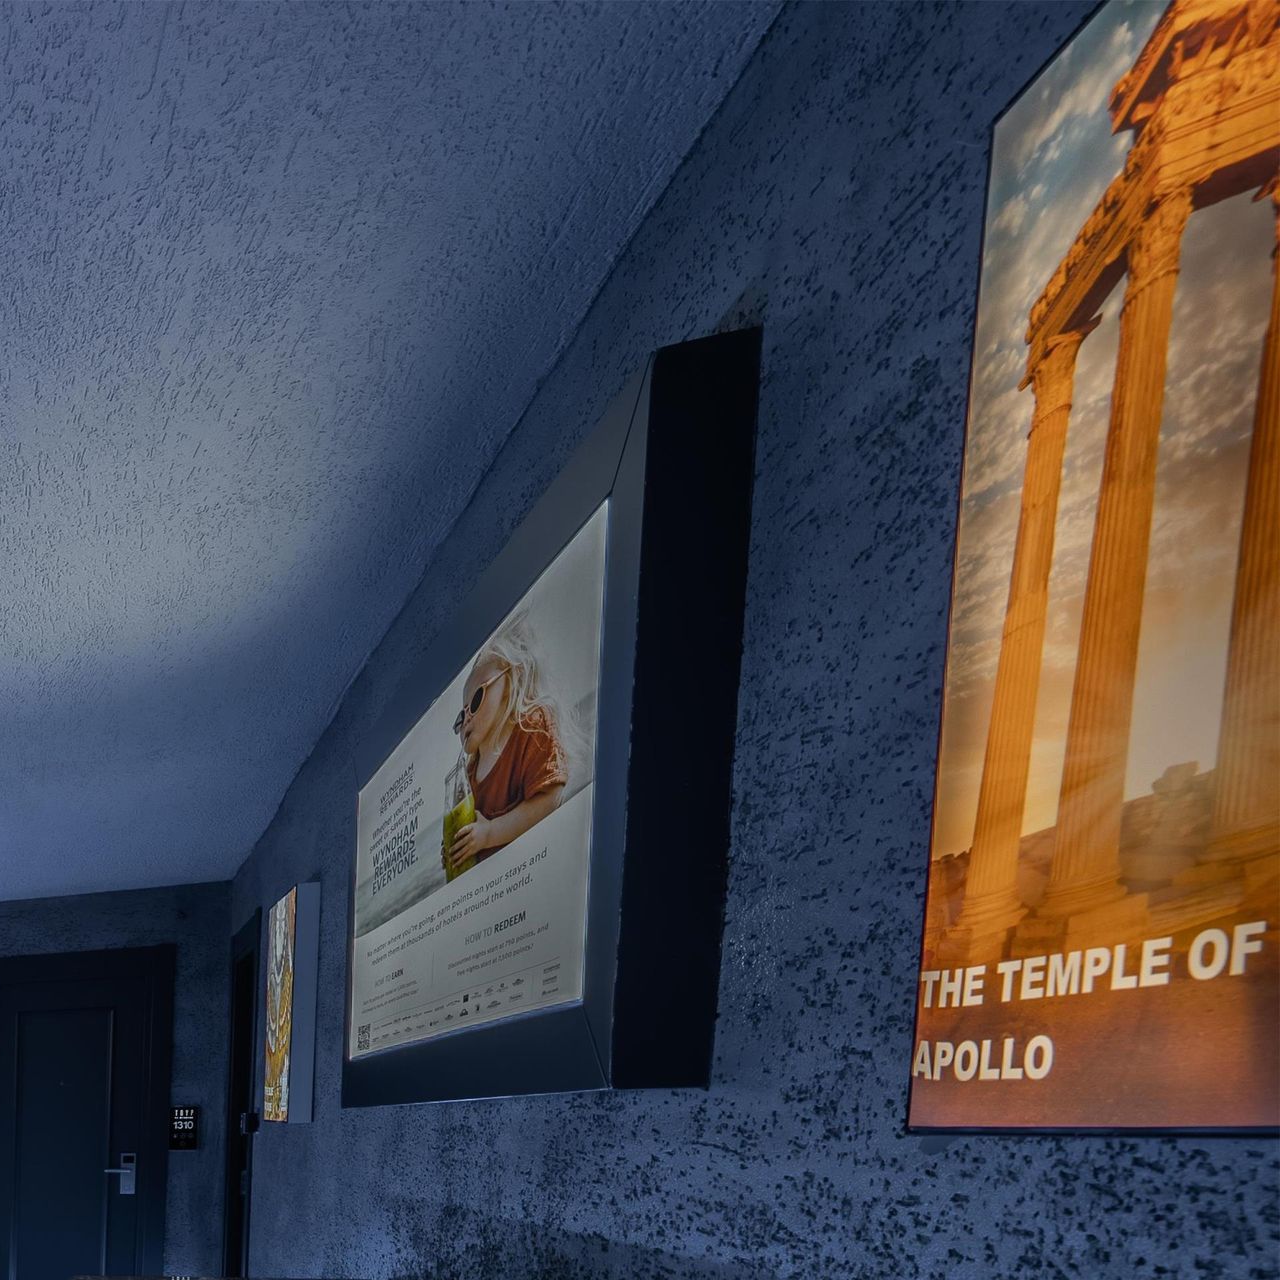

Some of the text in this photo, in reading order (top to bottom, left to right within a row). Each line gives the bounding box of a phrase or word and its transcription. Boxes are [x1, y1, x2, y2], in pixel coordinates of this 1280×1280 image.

[380, 762, 414, 803] WYNDHAM
[411, 787, 421, 801] the
[372, 816, 418, 867] WYNDHAM
[374, 833, 415, 880] REWARDS
[372, 848, 419, 897] EVERYONE.
[437, 905, 450, 917] earn
[451, 891, 473, 908] points
[474, 885, 484, 895] on
[485, 875, 503, 892] your
[504, 861, 527, 880] stays
[529, 846, 547, 866] and
[435, 920, 442, 931] of
[442, 911, 463, 928] hotels
[464, 896, 490, 916] around
[491, 890, 505, 903] the
[505, 873, 533, 894] world.
[464, 910, 526, 945] HOW TO REDEEM
[920, 920, 1268, 1008] THE TEMPLE OF
[911, 1034, 1054, 1081] APOLLO
[173, 1121, 194, 1130] 1310
